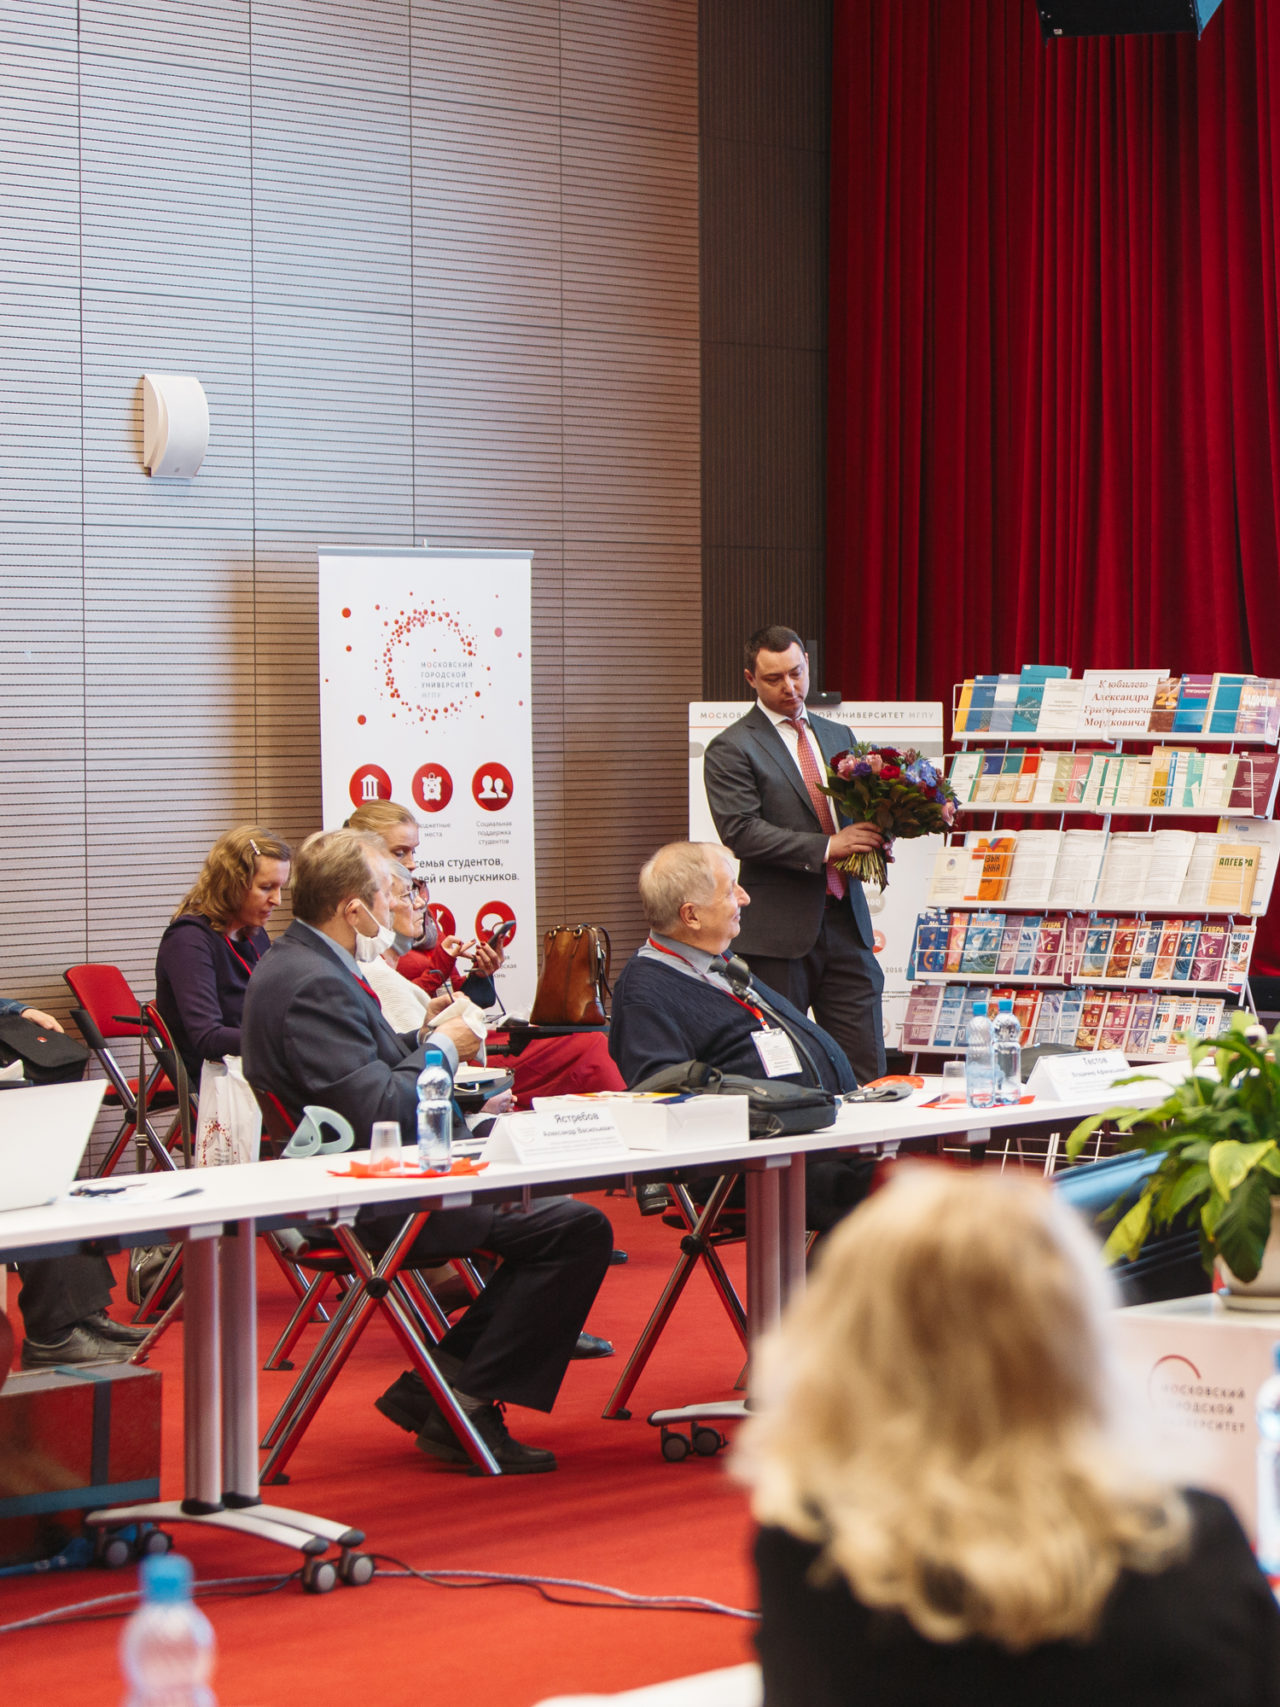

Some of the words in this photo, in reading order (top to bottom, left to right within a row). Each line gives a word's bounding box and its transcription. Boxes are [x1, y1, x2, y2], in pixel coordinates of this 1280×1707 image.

[421, 681, 474, 689] УНИВЕРСИТЕТ
[1108, 679, 1149, 689] юбилею
[836, 710, 905, 720] УНИВЕРСИТЕТ
[908, 711, 935, 720] МГПУ
[447, 857, 504, 870] студентов,
[439, 875, 446, 884] и
[448, 872, 520, 885] выпускников.
[554, 1112, 599, 1123] Ястребов
